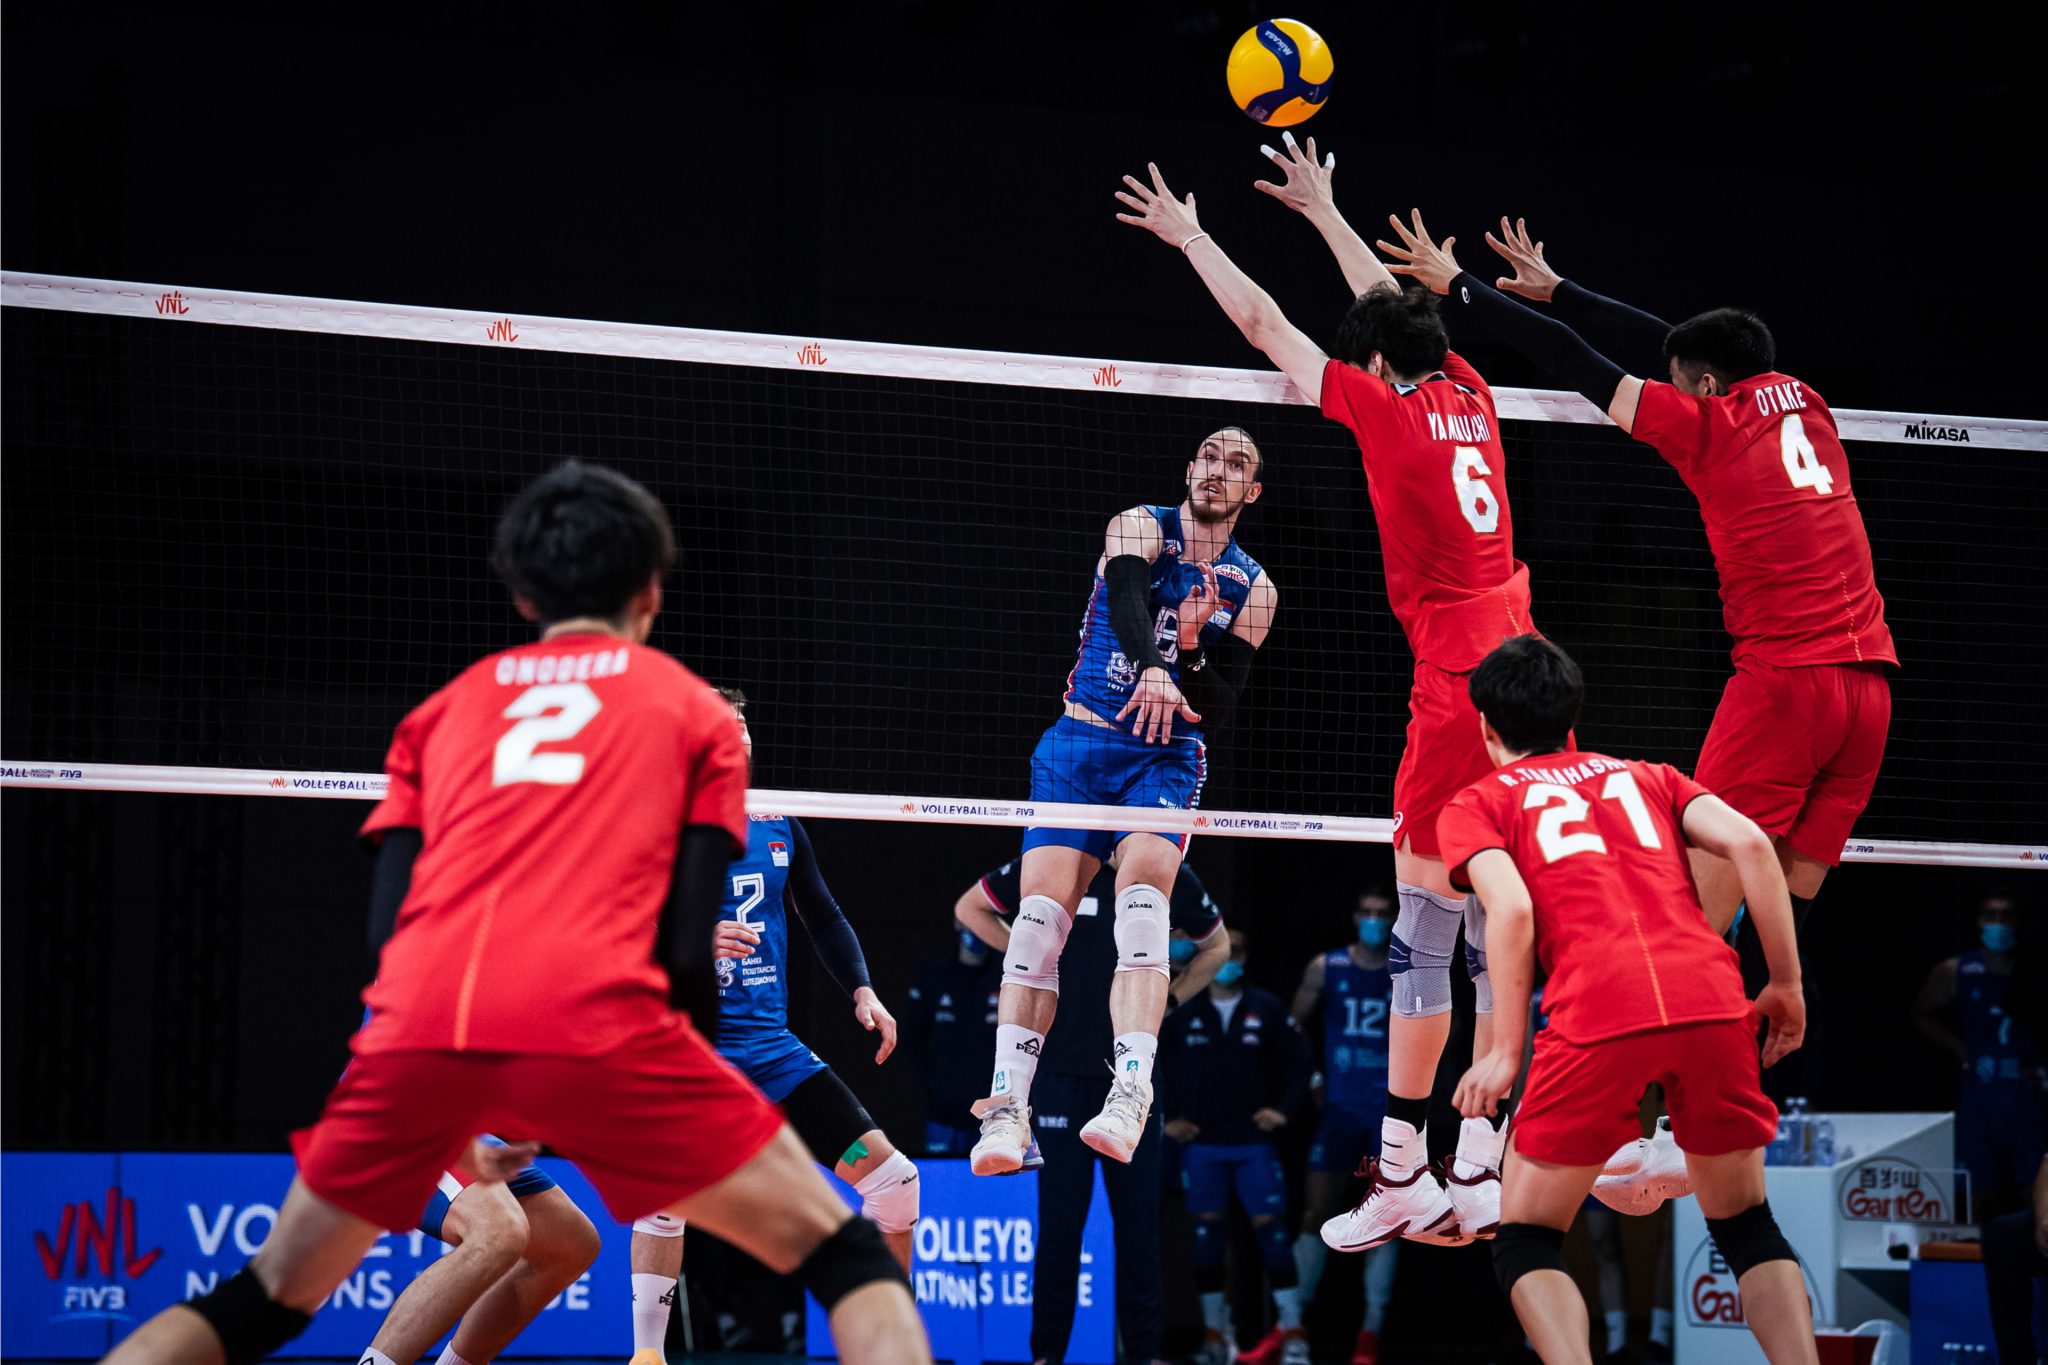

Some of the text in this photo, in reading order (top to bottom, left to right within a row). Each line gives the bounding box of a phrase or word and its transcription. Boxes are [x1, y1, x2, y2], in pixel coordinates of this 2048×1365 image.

[1755, 381, 1807, 417] OTAKE
[1780, 413, 1834, 495] 4
[1452, 445, 1500, 534] 6
[495, 646, 631, 686] ONODERA
[493, 682, 603, 788] 2
[293, 779, 367, 791] VOLLEYBALL
[921, 804, 989, 816] VOLLEYBALL
[1213, 818, 1278, 830] VOLLEYBALL
[1522, 770, 1662, 864] 21
[732, 872, 766, 933] 2
[1343, 997, 1386, 1038] 12
[1015, 1042, 1040, 1058] PEA
[35, 1186, 163, 1280] VNL
[64, 1286, 126, 1310] FIVB
[910, 1270, 994, 1310] ATIONS
